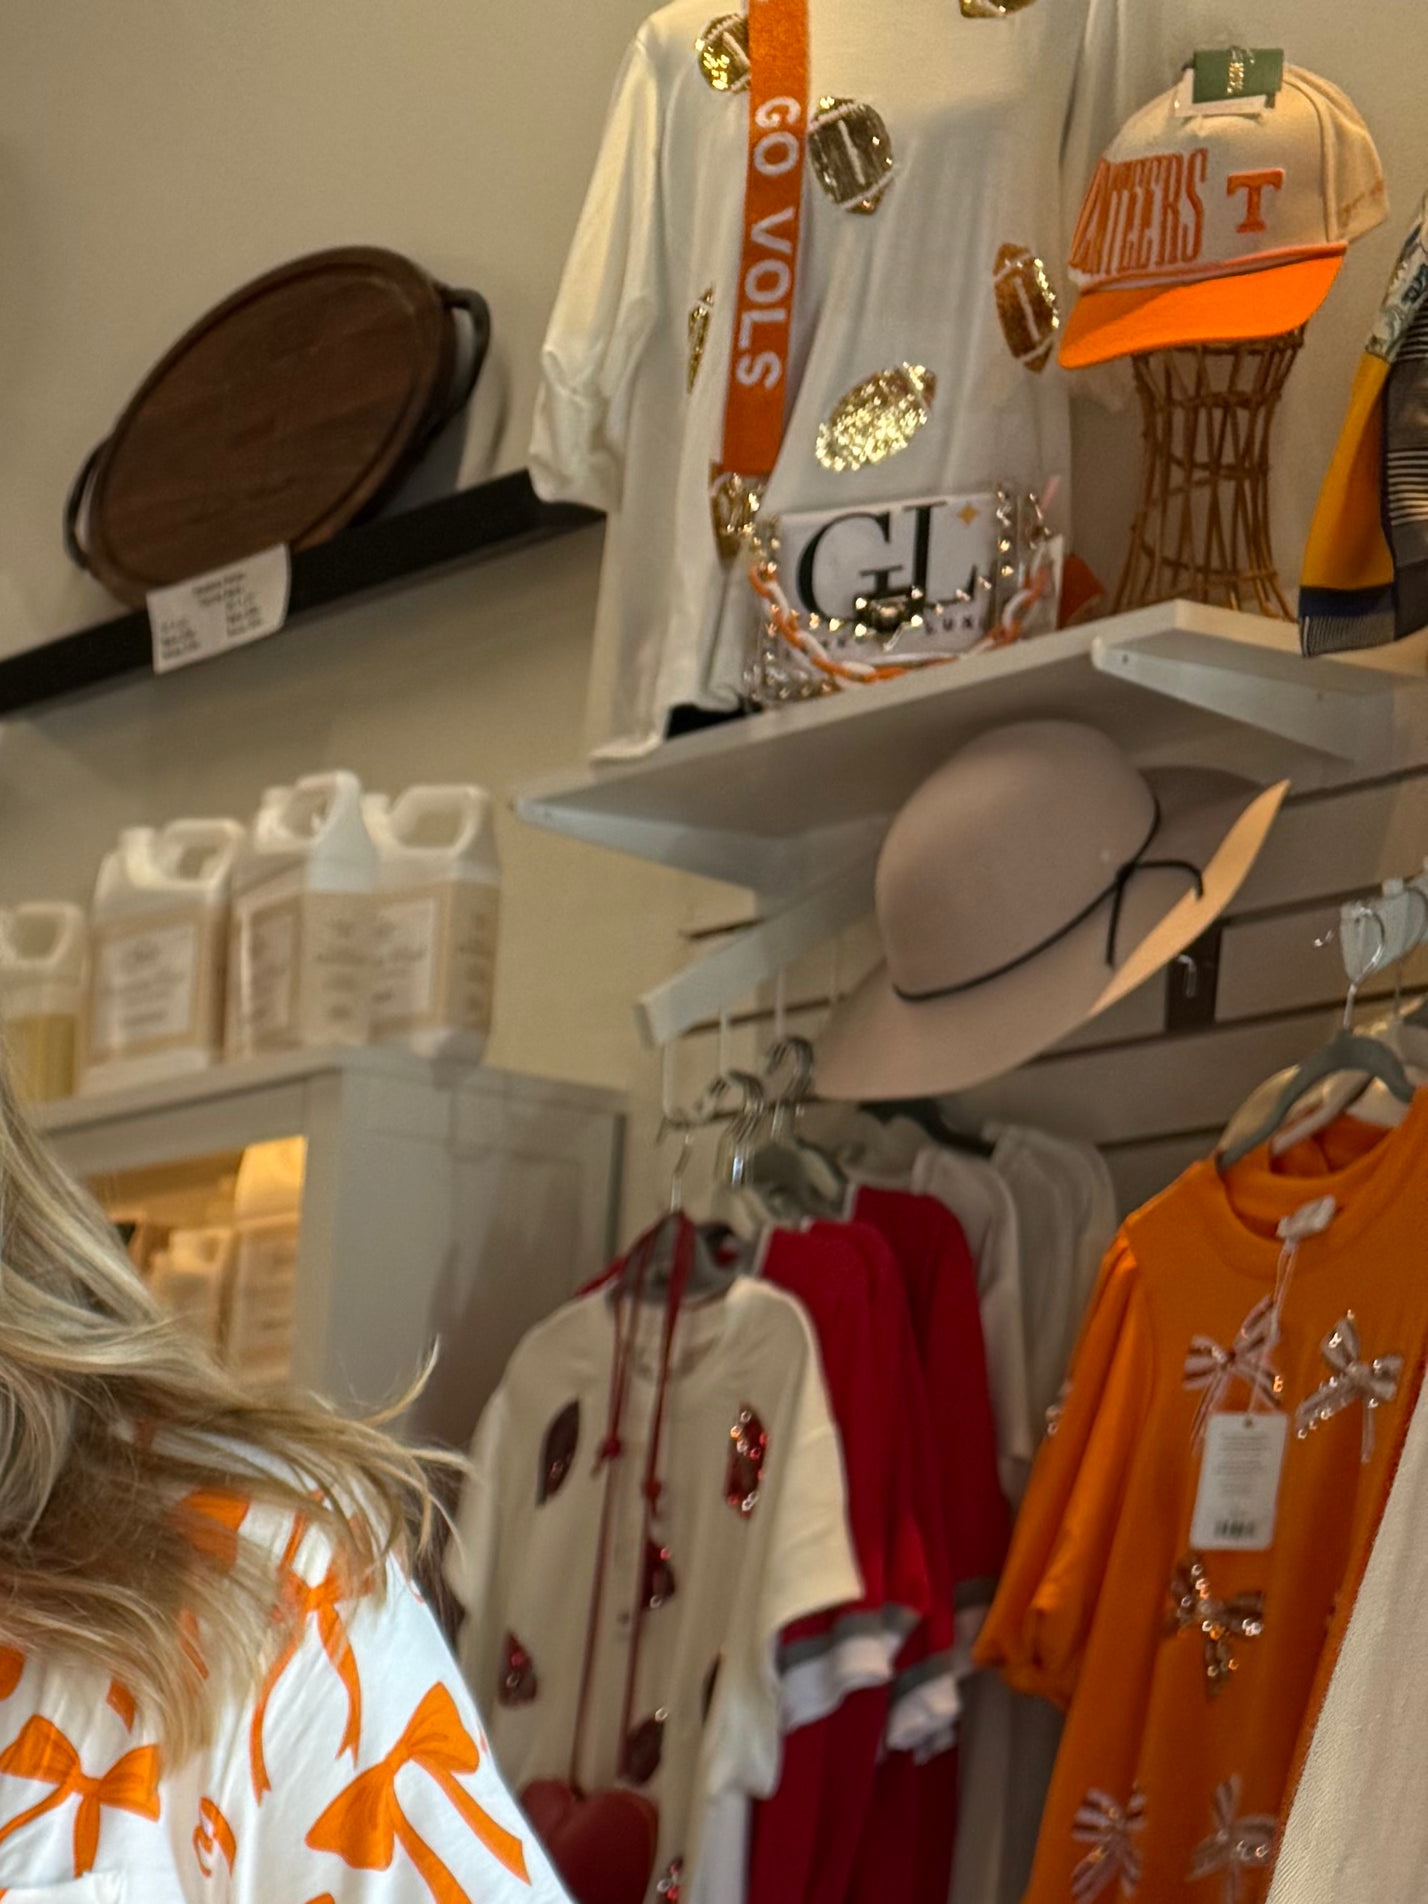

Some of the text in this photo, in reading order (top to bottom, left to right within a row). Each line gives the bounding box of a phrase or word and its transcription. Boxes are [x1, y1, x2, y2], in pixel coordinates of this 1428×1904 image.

[735, 96, 802, 390] GO VOLS
[1226, 167, 1285, 234] T
